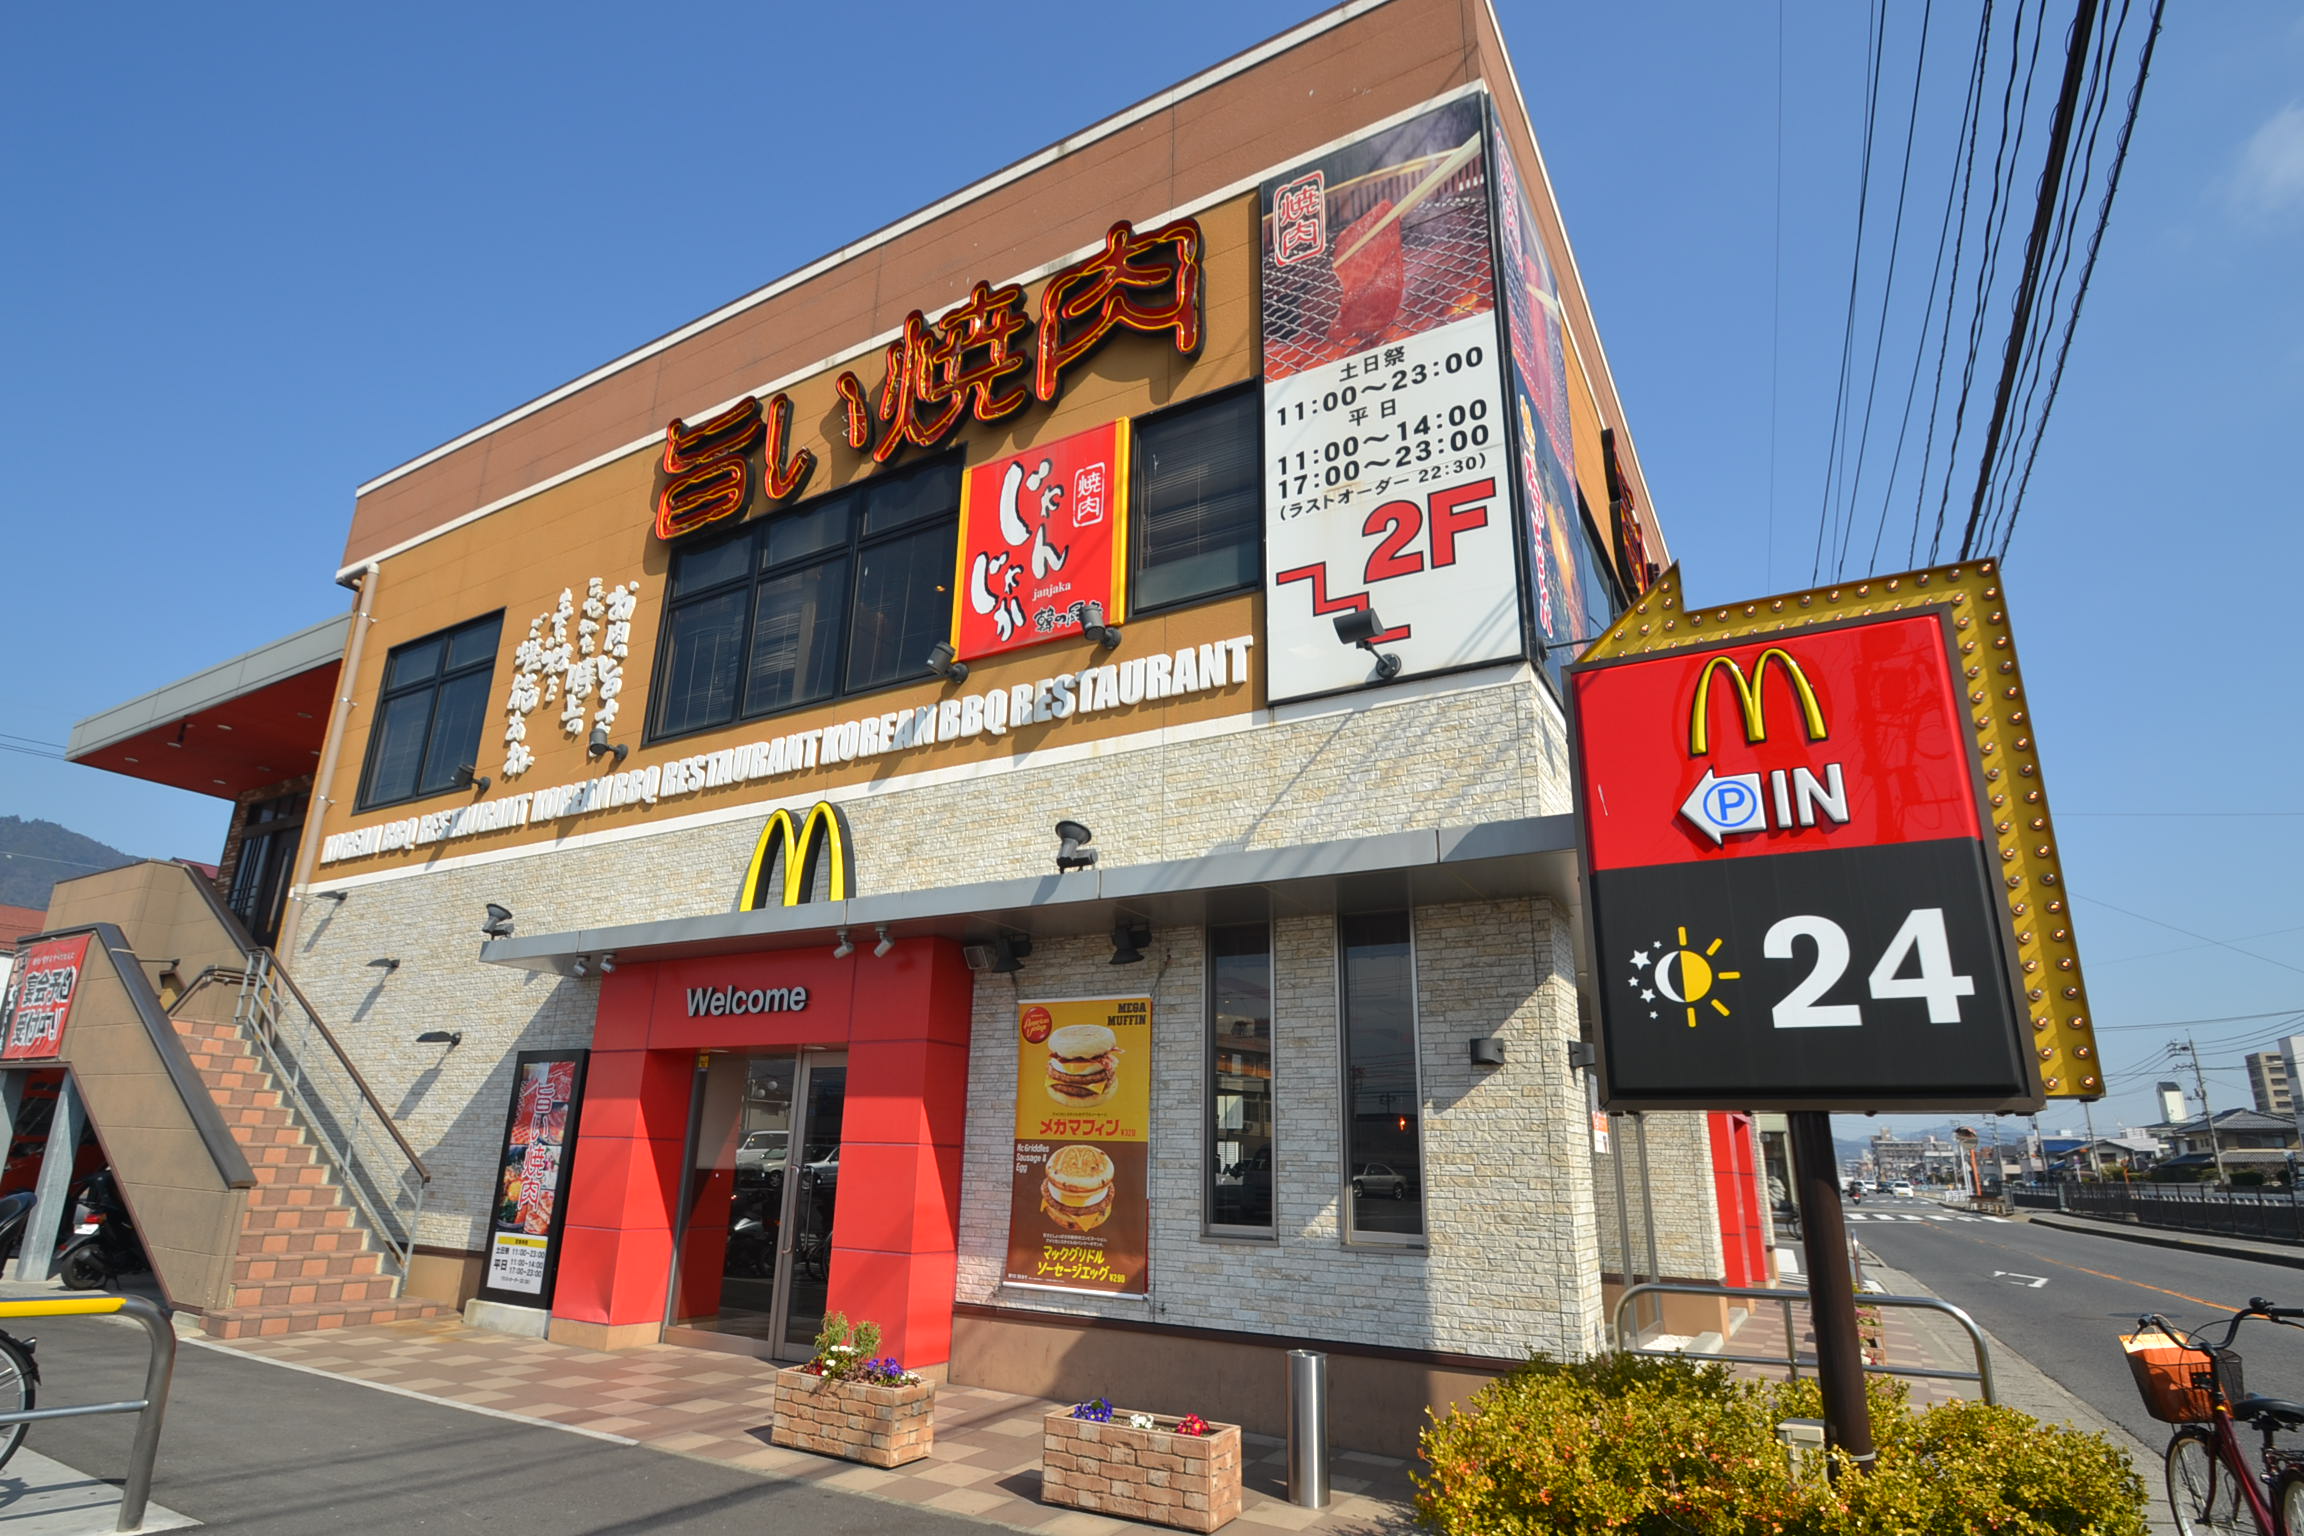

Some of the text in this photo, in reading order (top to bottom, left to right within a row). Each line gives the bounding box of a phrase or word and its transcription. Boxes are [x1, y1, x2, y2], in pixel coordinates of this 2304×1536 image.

[1280, 184, 1321, 257] 焼肉
[655, 217, 1204, 540] 旨い焼肉
[1339, 345, 1405, 383] 土日祭
[1077, 470, 1102, 521] 焼肉
[1361, 476, 1497, 585] 2F
[1032, 581, 1072, 601] janjaka
[321, 634, 1255, 864] KOREAN BBQ RESTAURANT KOREAN BBQ RESTAURANT KOREAN BBQ RESTAURANT
[1770, 762, 1851, 829] IN
[1763, 907, 1976, 1030] 24
[686, 985, 807, 1017] Welcome
[1117, 1002, 1147, 1013] MEGA
[1107, 1015, 1147, 1026] MUFFIN
[1040, 1119, 1120, 1136] メガマフィン
[517, 1083, 556, 1211] 旨い焼肉
[1016, 1153, 1041, 1164] Sausage
[1016, 1162, 1028, 1173] Egg
[1037, 1261, 1111, 1281] ソーセージエッグ
[1043, 1245, 1105, 1265] マックグリドル
